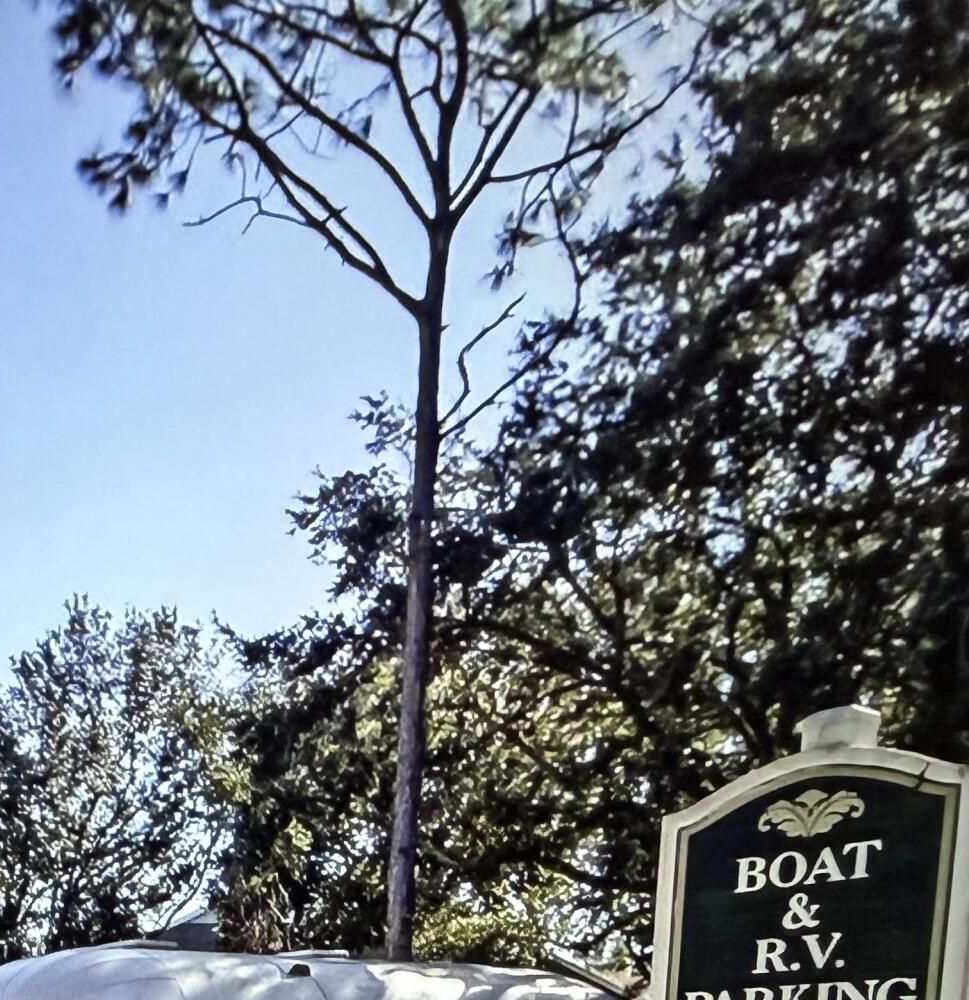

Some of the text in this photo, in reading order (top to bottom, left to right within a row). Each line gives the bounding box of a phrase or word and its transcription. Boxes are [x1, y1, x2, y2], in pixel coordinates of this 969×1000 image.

[734, 839, 882, 894] BOAT
[782, 893, 820, 930] &
[751, 932, 845, 974] R.V.
